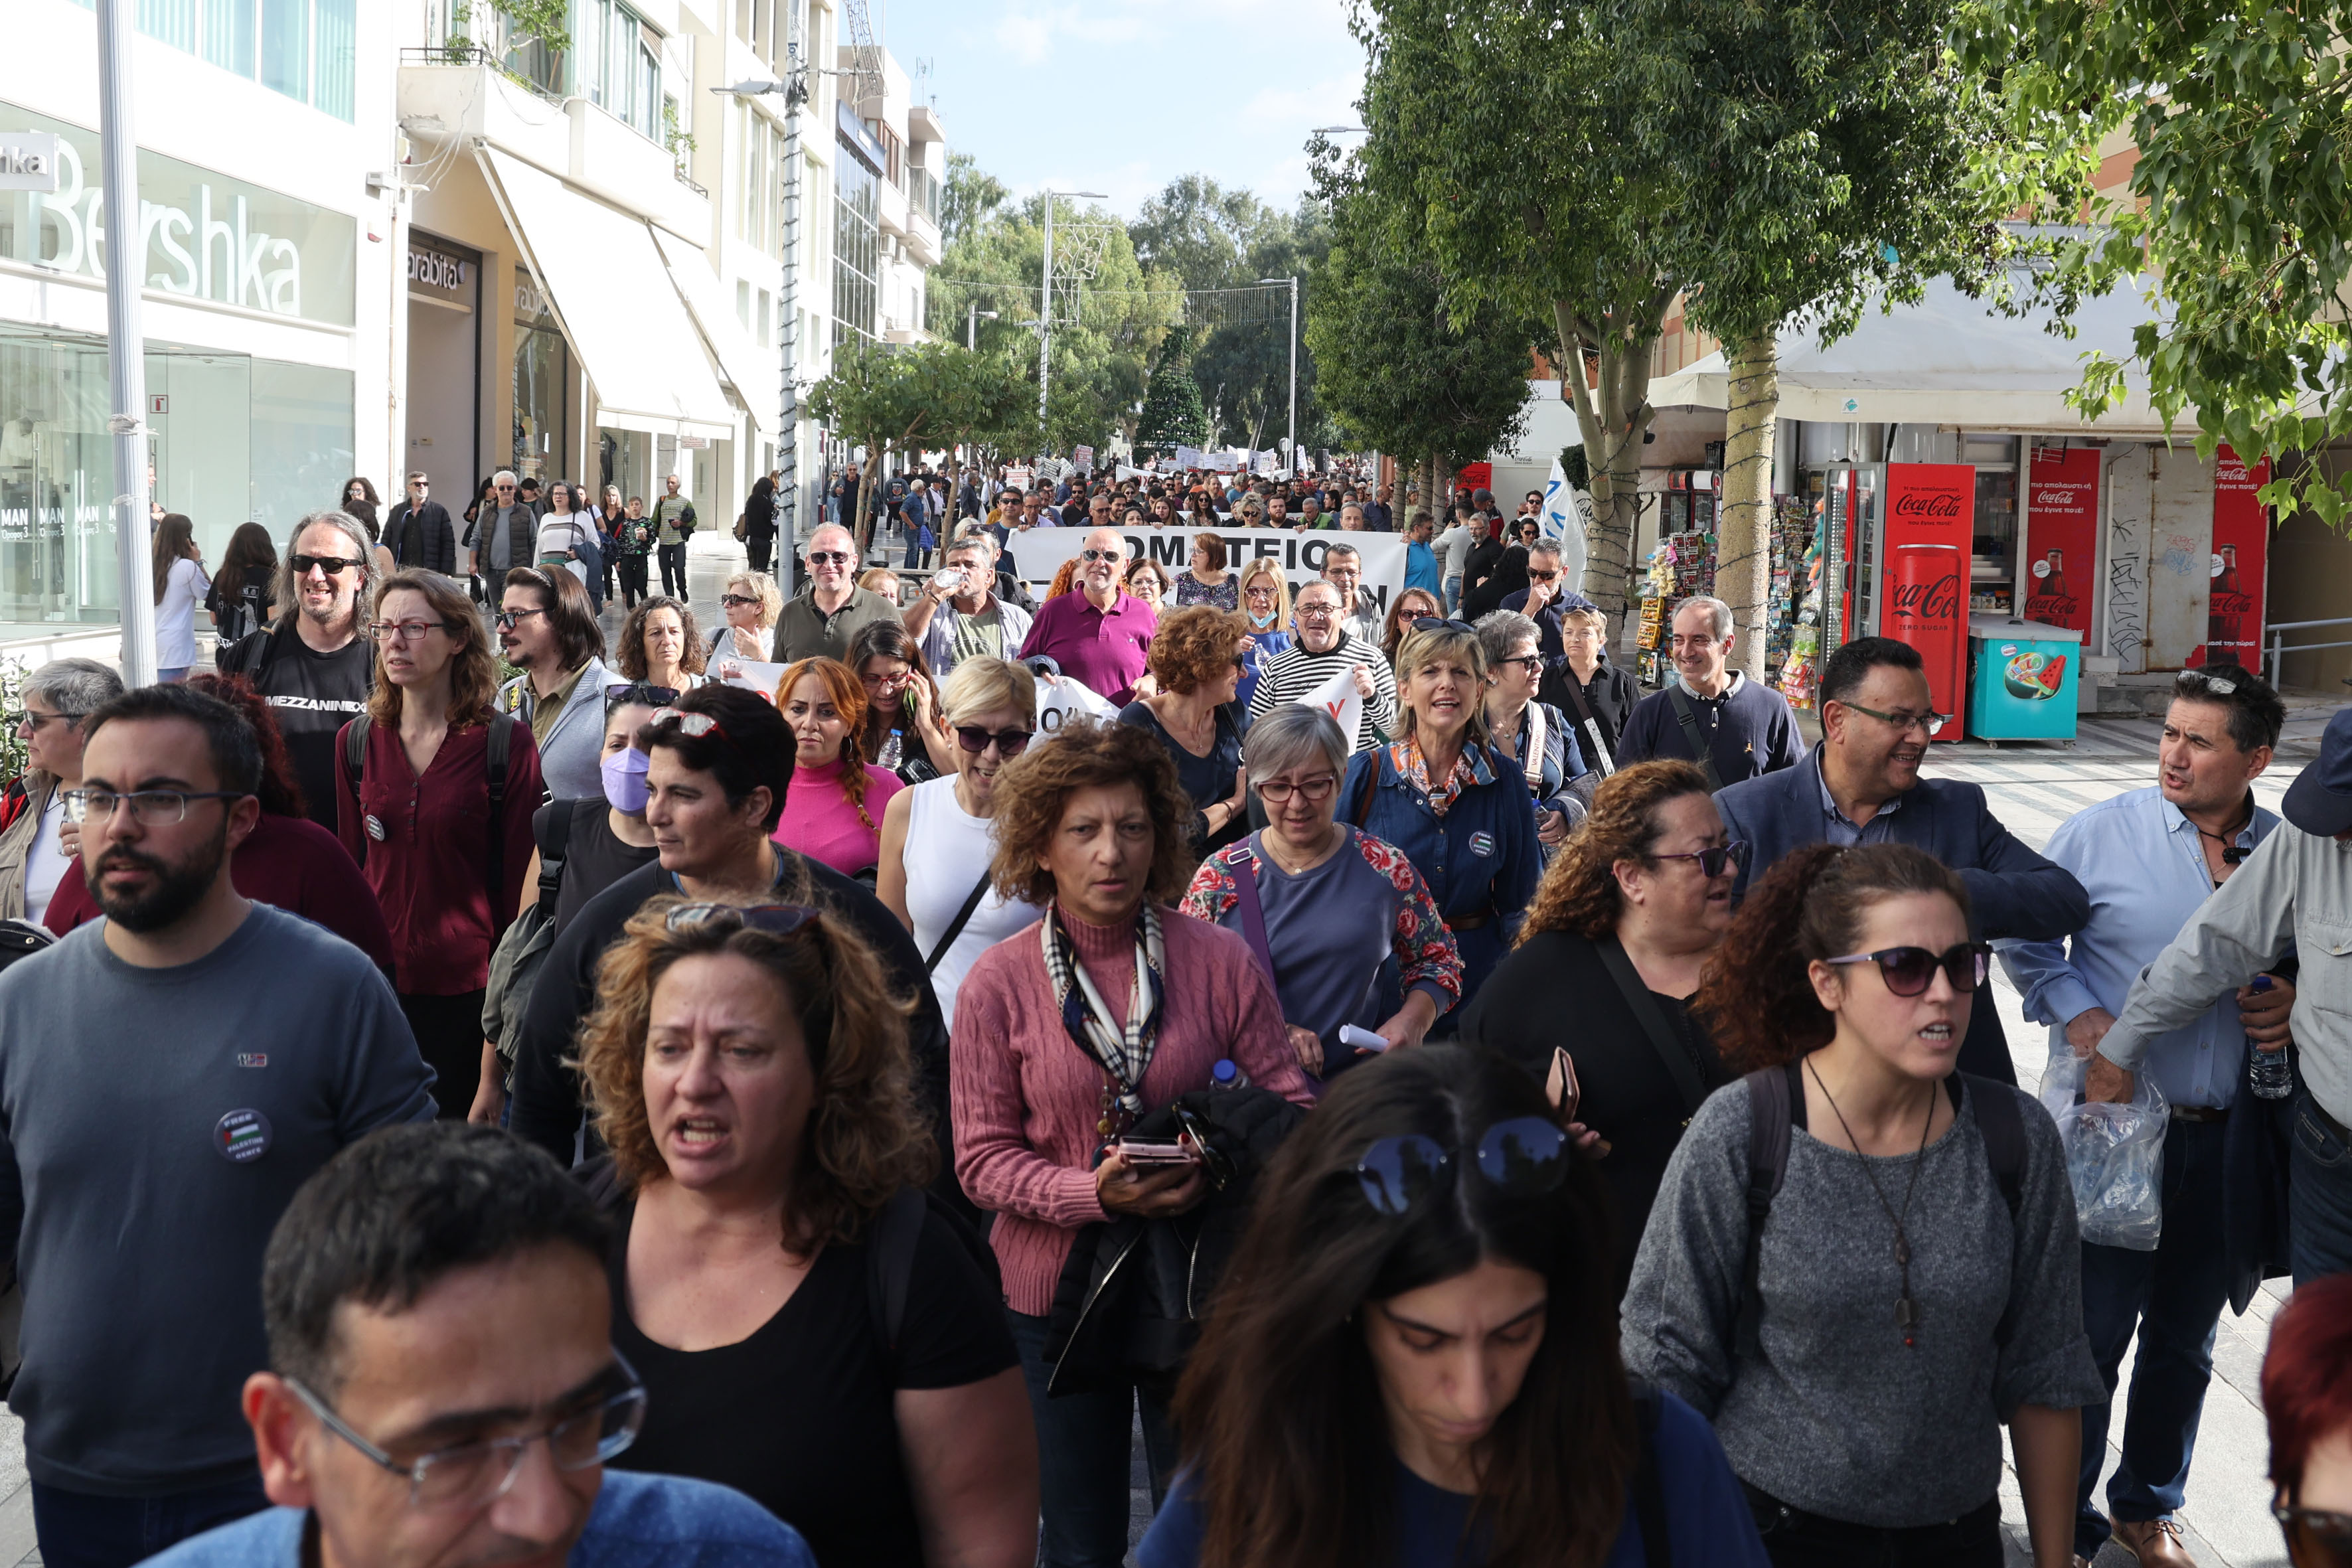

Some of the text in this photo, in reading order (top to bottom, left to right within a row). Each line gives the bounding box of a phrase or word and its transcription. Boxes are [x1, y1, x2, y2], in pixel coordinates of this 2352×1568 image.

[29, 129, 300, 317] Bershka
[1896, 494, 1964, 516] Coca-Cola
[2037, 491, 2075, 504] Coca-Cola
[1, 509, 28, 526] MAN
[40, 507, 64, 524] MAN
[227, 1137, 264, 1153] PALESTINE
